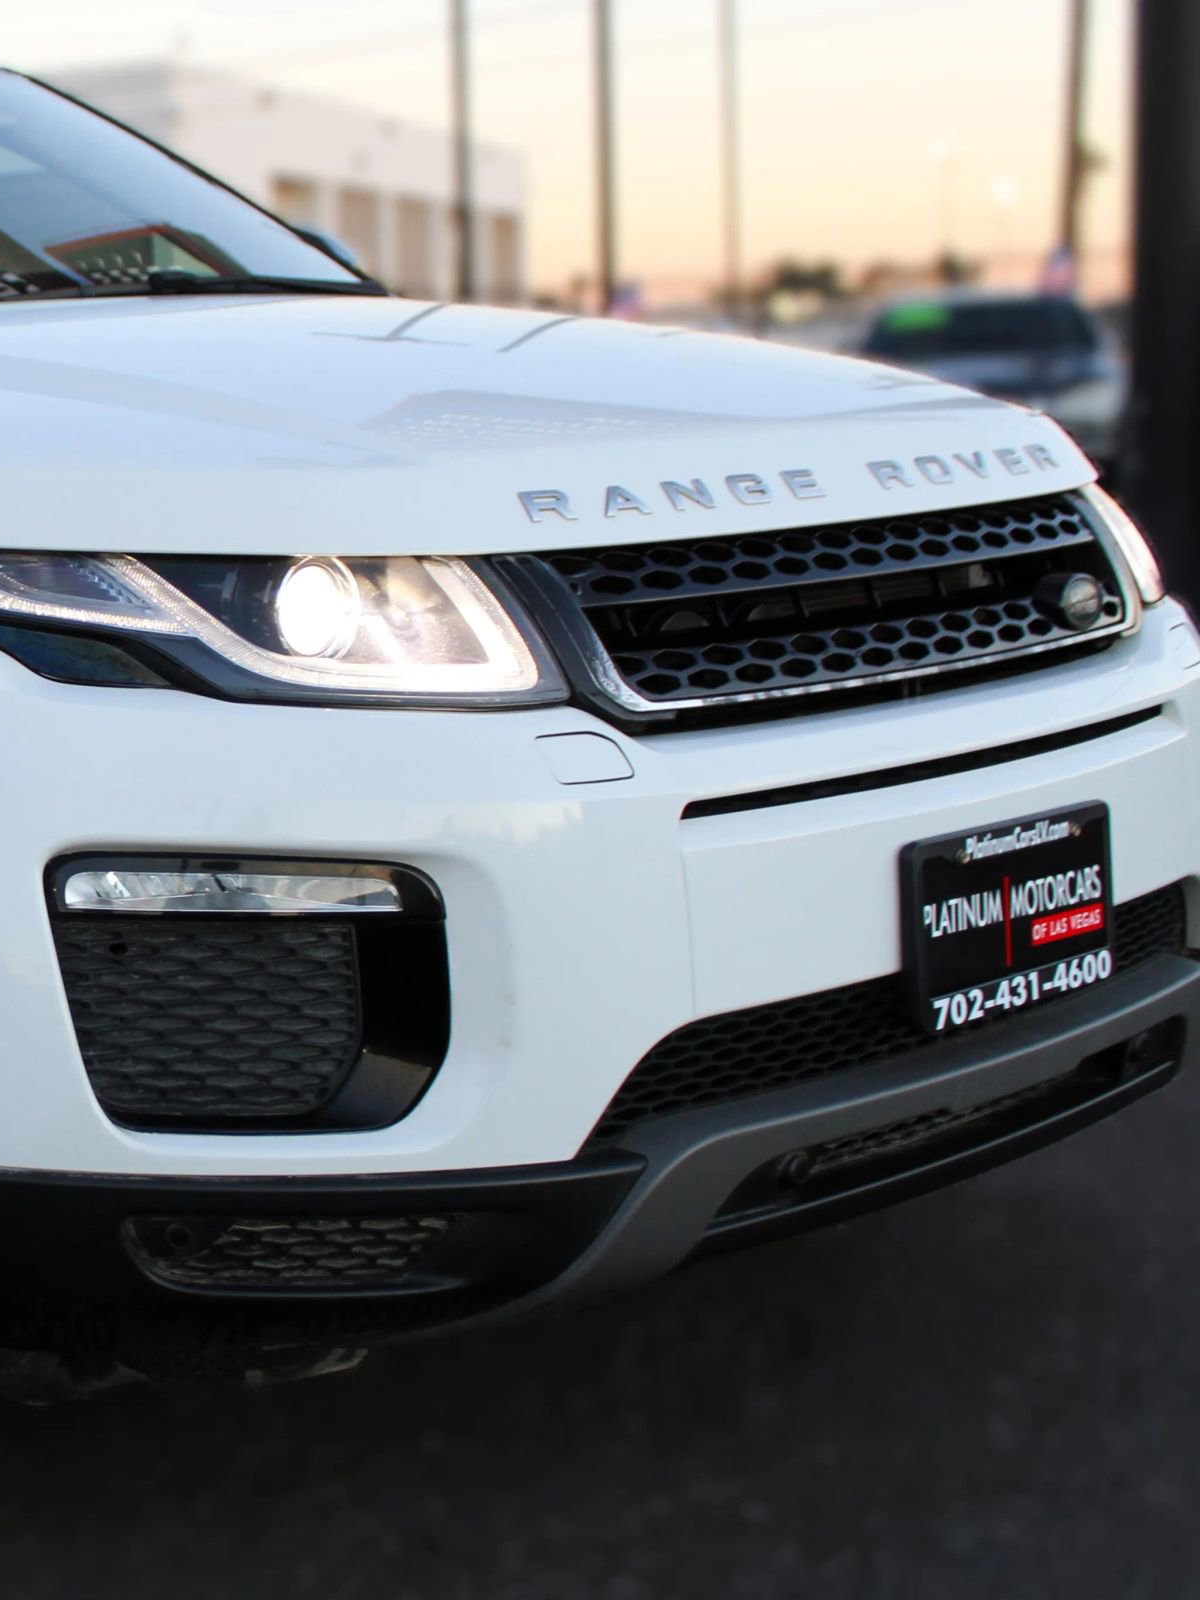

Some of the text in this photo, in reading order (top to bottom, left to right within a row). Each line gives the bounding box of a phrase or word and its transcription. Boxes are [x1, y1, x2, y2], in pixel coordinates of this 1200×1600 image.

[517, 442, 1061, 523] RANGE ROVER
[923, 864, 1102, 938] PLATINUM MOTORCARS
[1032, 908, 1101, 941] OF LAS VEGAS
[933, 949, 1112, 1031] 702-431-4600
